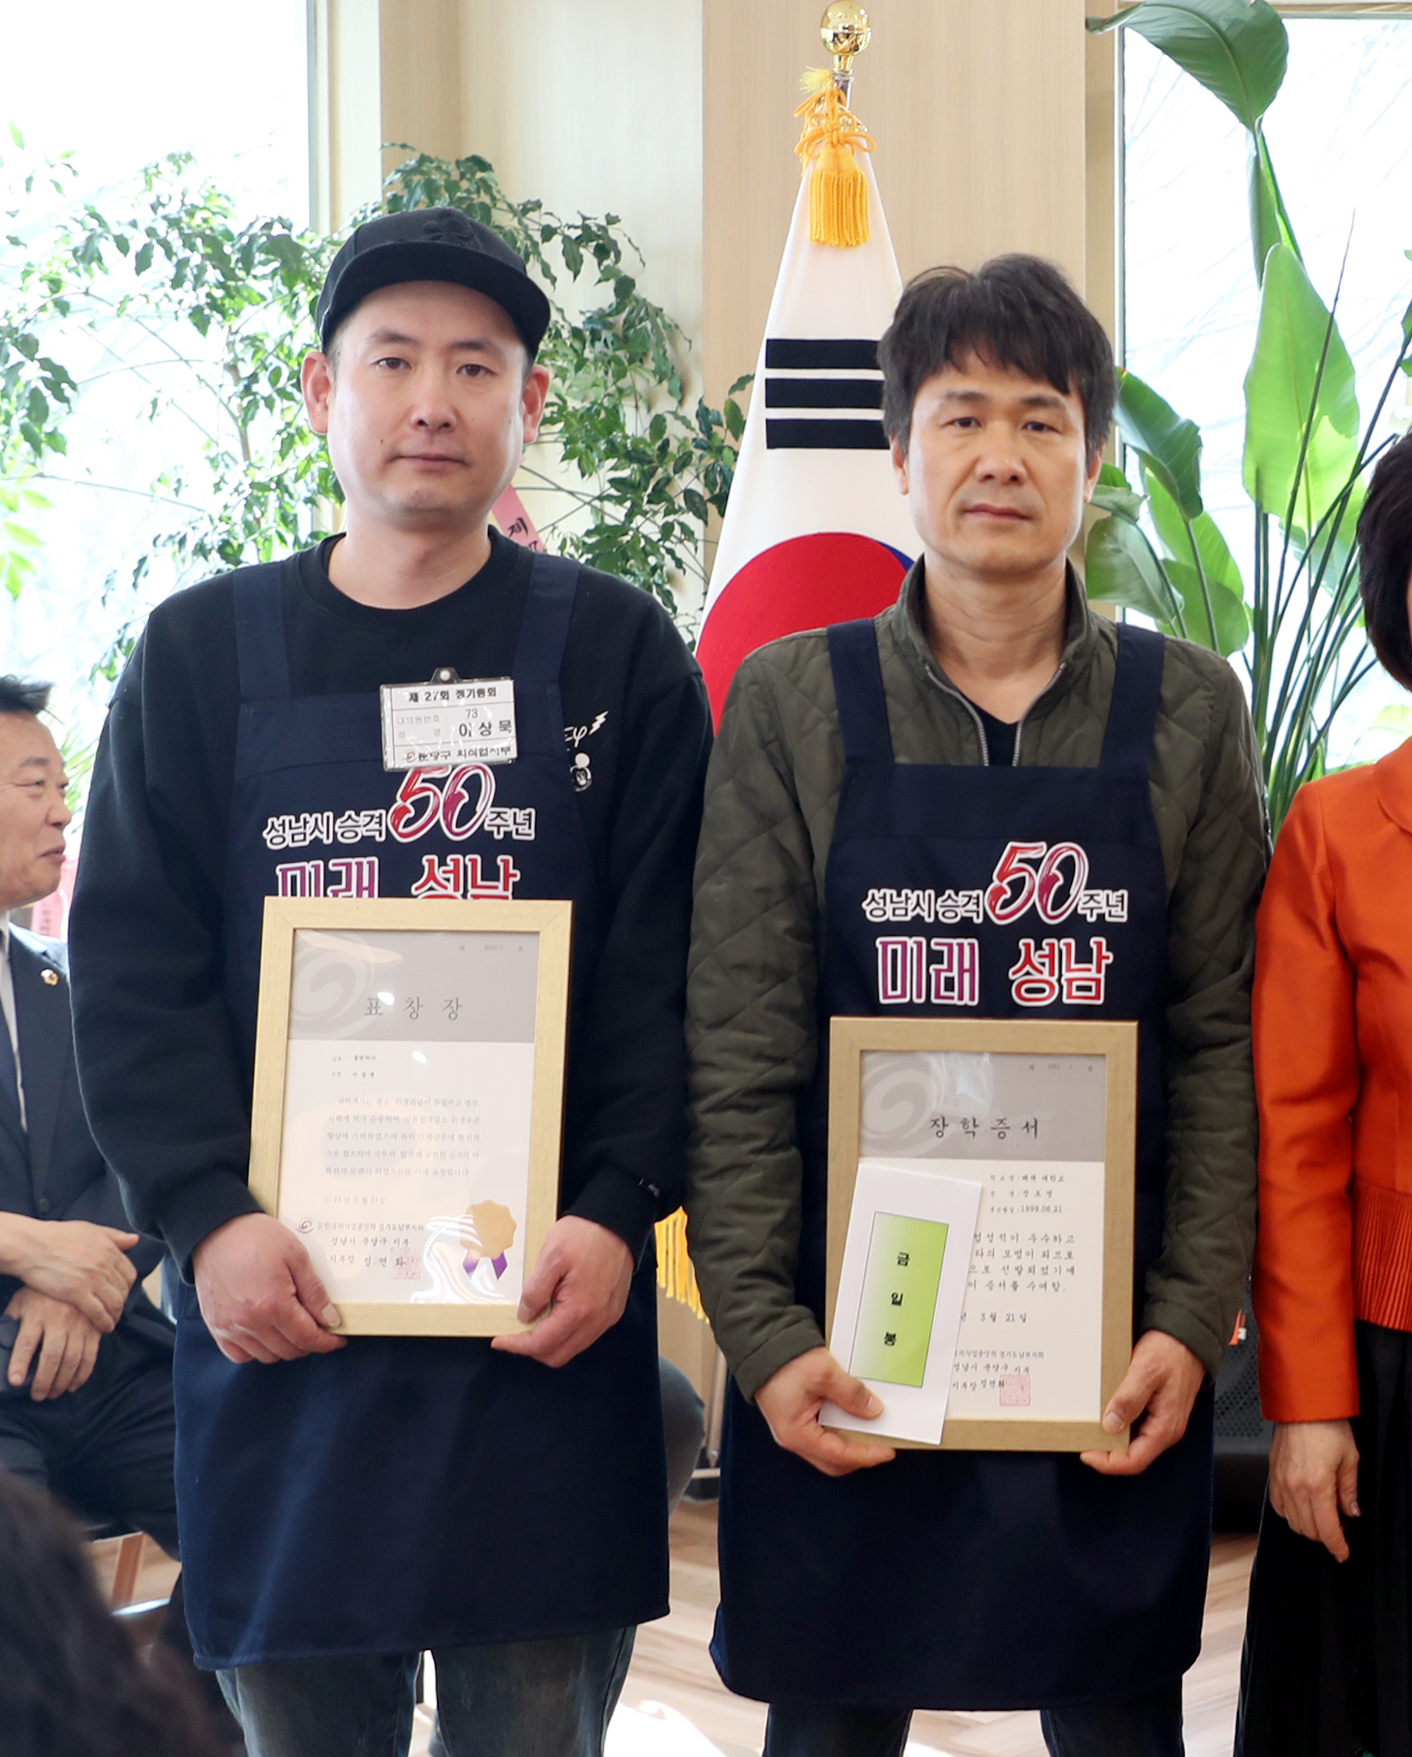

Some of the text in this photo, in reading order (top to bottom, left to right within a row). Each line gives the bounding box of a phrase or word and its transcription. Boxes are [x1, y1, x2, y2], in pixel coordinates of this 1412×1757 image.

[408, 687, 497, 703] 제 27회 정기총회
[465, 708, 478, 719] 73
[263, 811, 334, 850] 성남시
[335, 809, 387, 842] 승격
[861, 888, 935, 923] 성남시
[936, 889, 984, 924] 승격
[875, 935, 1114, 1007] 미래 성남
[929, 1116, 1039, 1140] 장학증서
[882, 1250, 912, 1348] 금일봉
